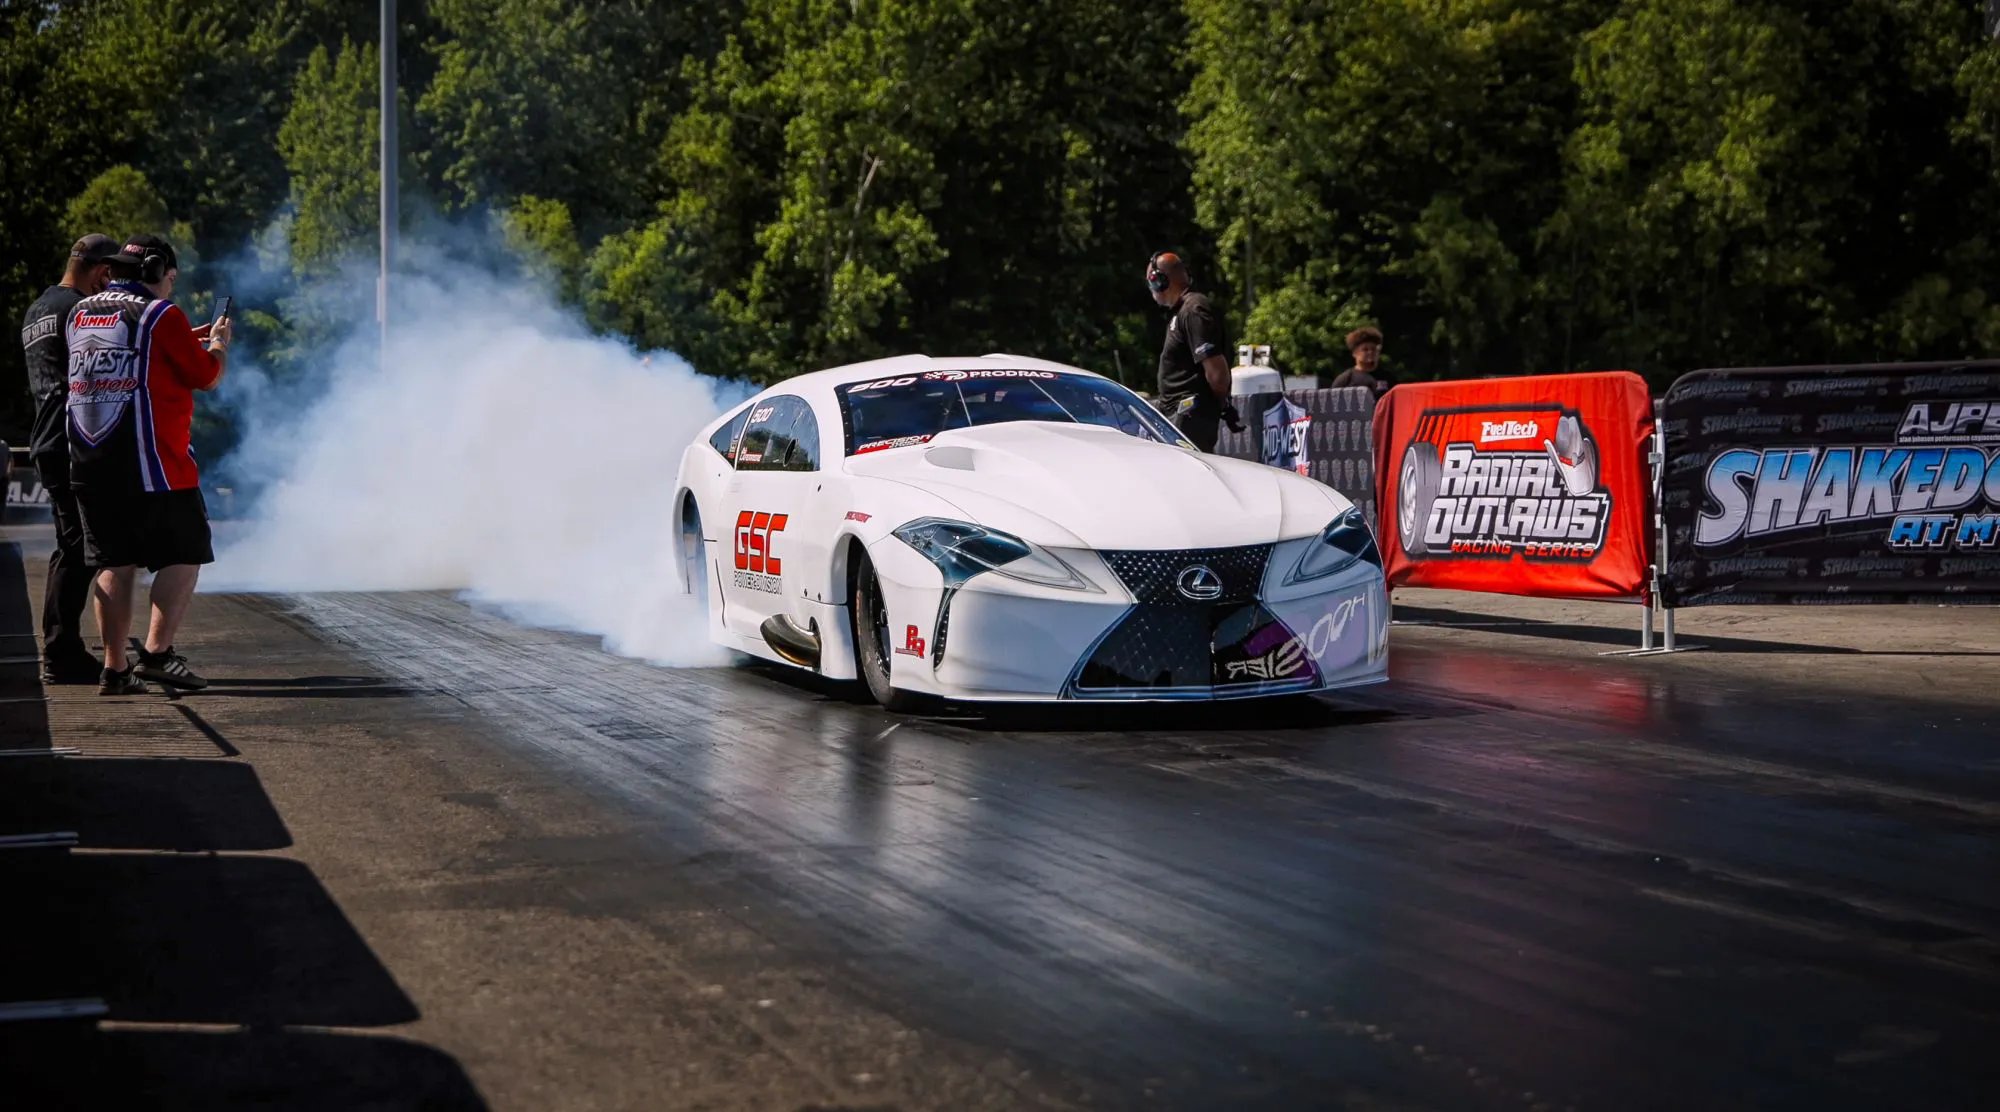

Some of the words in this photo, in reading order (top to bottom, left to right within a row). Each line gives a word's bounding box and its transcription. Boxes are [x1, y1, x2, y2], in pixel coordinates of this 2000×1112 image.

[70, 349, 135, 375] D-WEST
[847, 377, 918, 393] 500
[969, 370, 1055, 379] PRODRAG
[69, 380, 88, 395] RO
[92, 378, 138, 395] MOD
[751, 407, 775, 423] 500
[1262, 419, 1310, 459] MID-WEST
[1480, 420, 1538, 440] FuelTech
[1439, 449, 1565, 497] RADIAL
[1424, 498, 1600, 544] OUTLAWS
[1889, 514, 1957, 546] AT
[1956, 514, 2000, 546] M
[735, 510, 789, 576] GSC
[1452, 539, 1511, 553] RACING
[1525, 541, 1596, 557] SERIES
